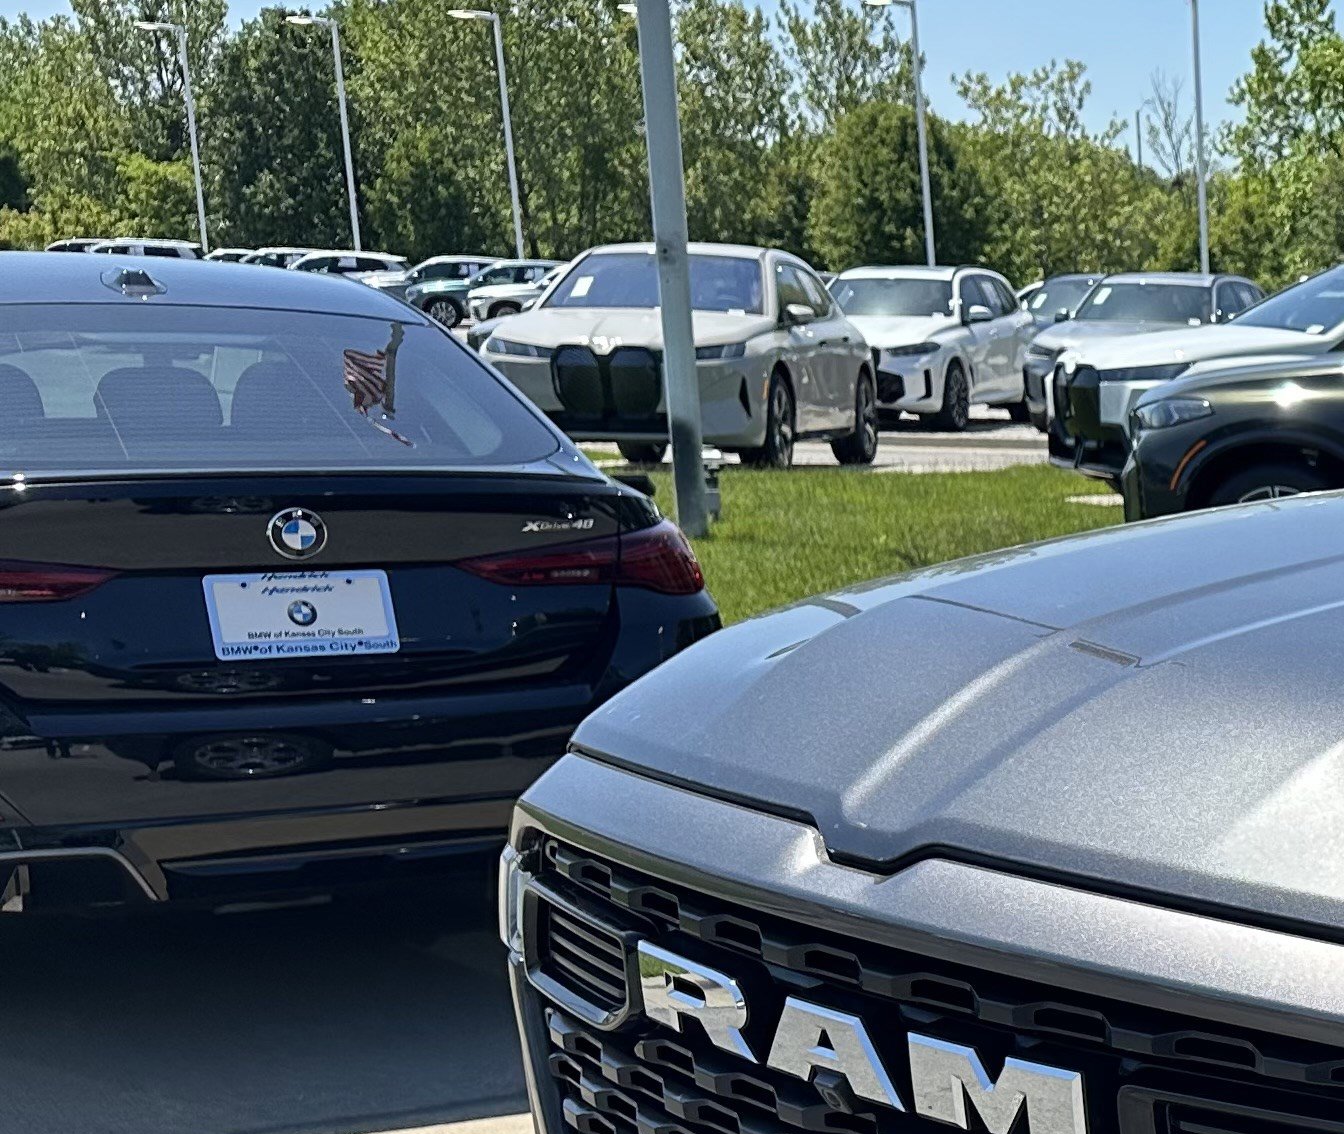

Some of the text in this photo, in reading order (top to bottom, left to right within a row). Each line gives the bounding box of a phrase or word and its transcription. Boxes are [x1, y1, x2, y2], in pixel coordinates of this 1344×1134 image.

[248, 627, 364, 640] BMW of Kansas City South
[222, 640, 398, 656] BMW of Kansas City South
